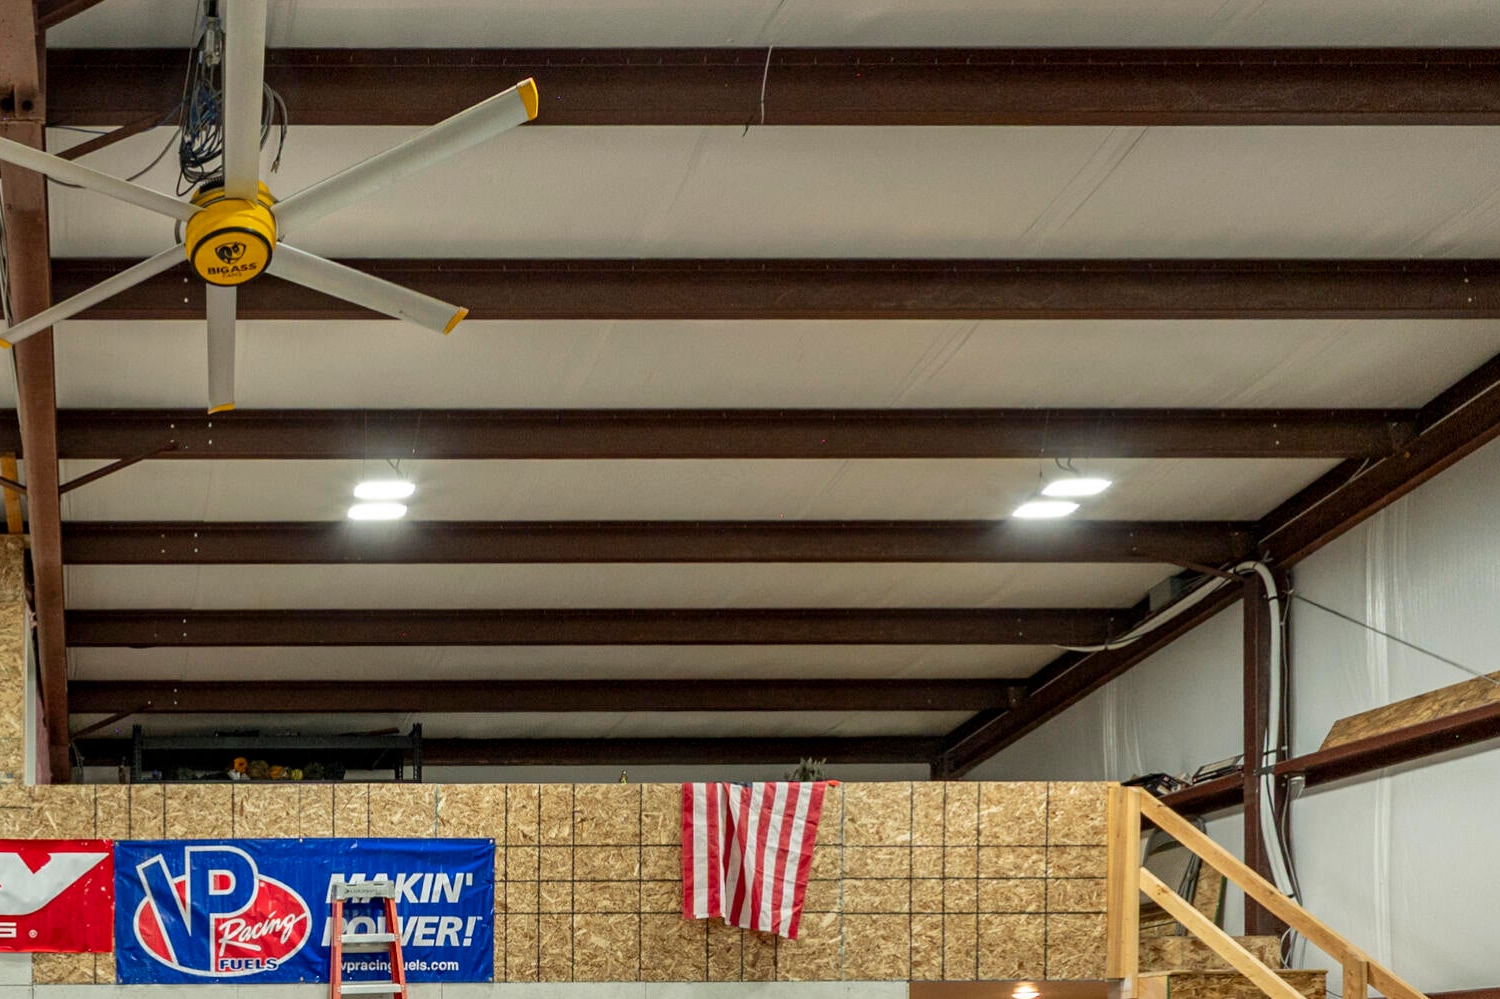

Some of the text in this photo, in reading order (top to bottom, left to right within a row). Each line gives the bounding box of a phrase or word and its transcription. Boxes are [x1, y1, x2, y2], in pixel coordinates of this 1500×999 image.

[207, 262, 257, 274] BIG ASS
[136, 845, 260, 973] VP
[218, 910, 304, 957] Racing
[219, 957, 279, 971] FUELS
[340, 959, 459, 973] vpracinguels.com
